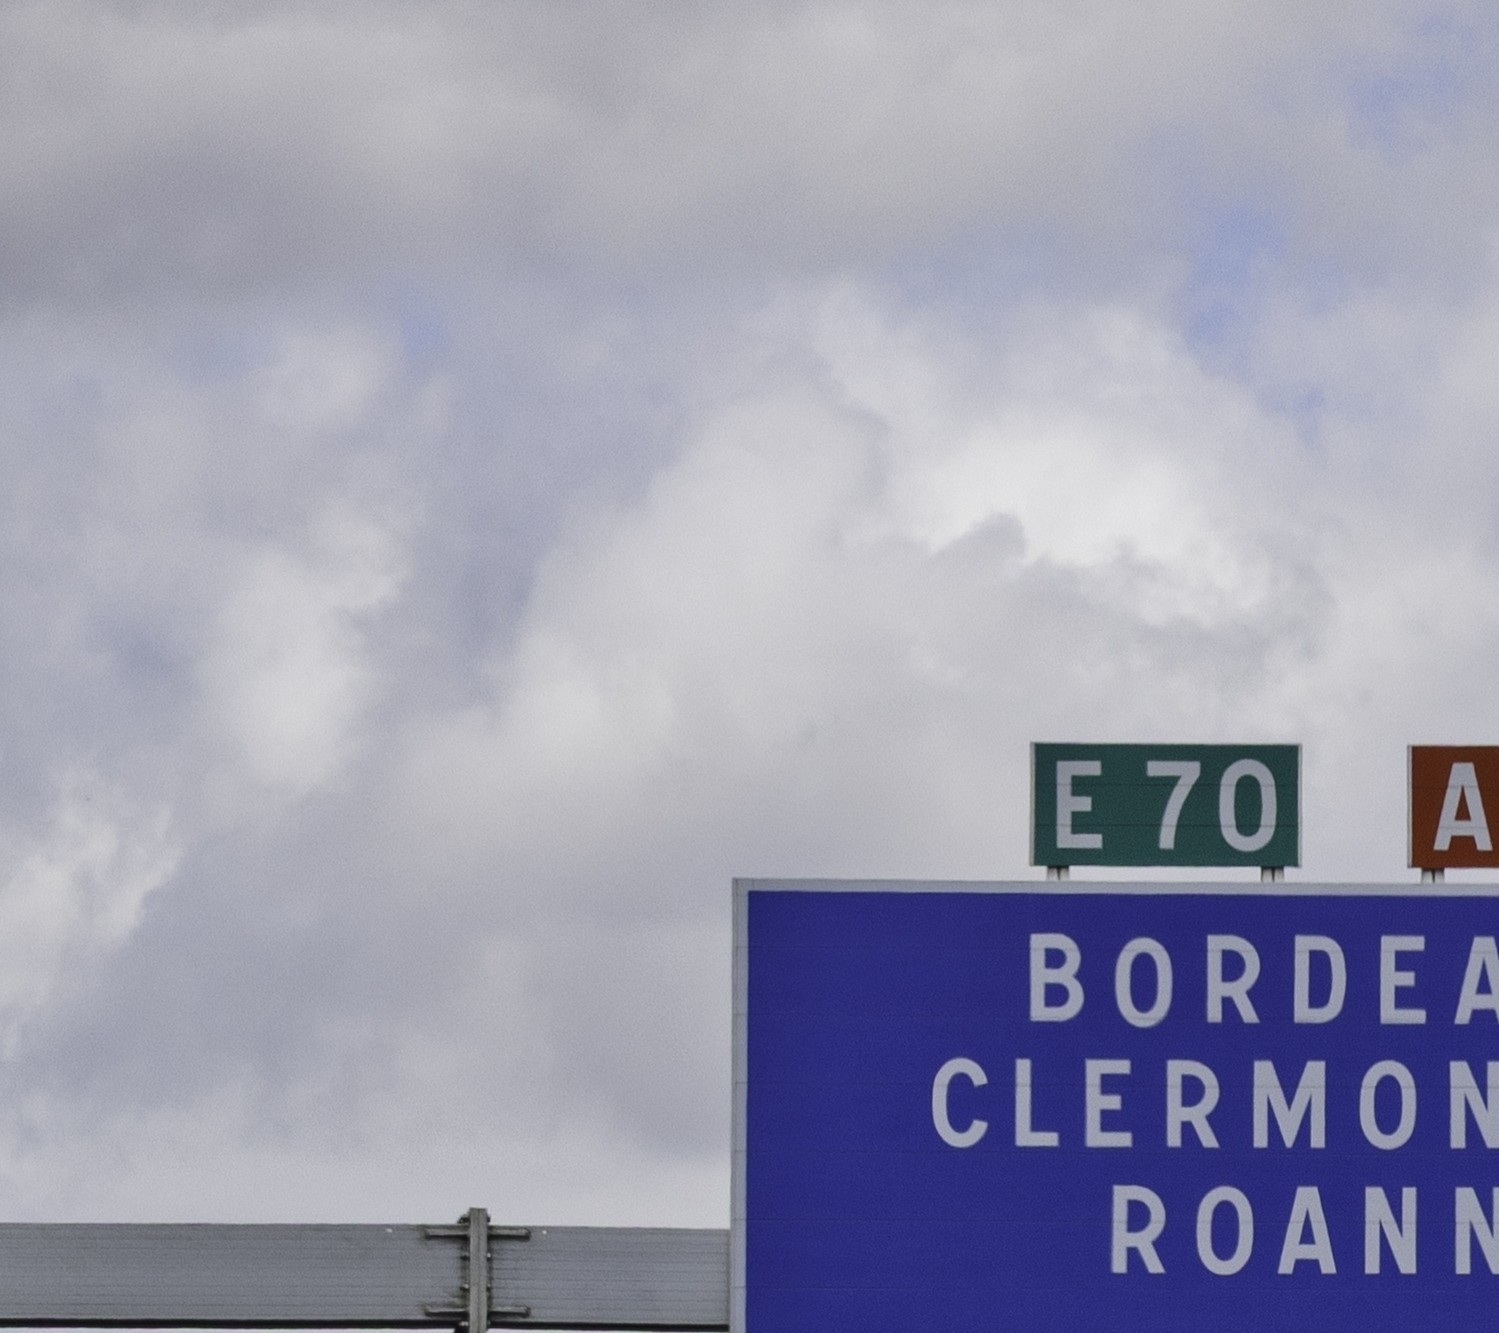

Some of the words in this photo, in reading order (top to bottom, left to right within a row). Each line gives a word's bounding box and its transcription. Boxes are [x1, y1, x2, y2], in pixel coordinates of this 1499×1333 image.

[1057, 760, 1103, 849] E
[1147, 758, 1277, 852] 70
[1434, 762, 1493, 851] A
